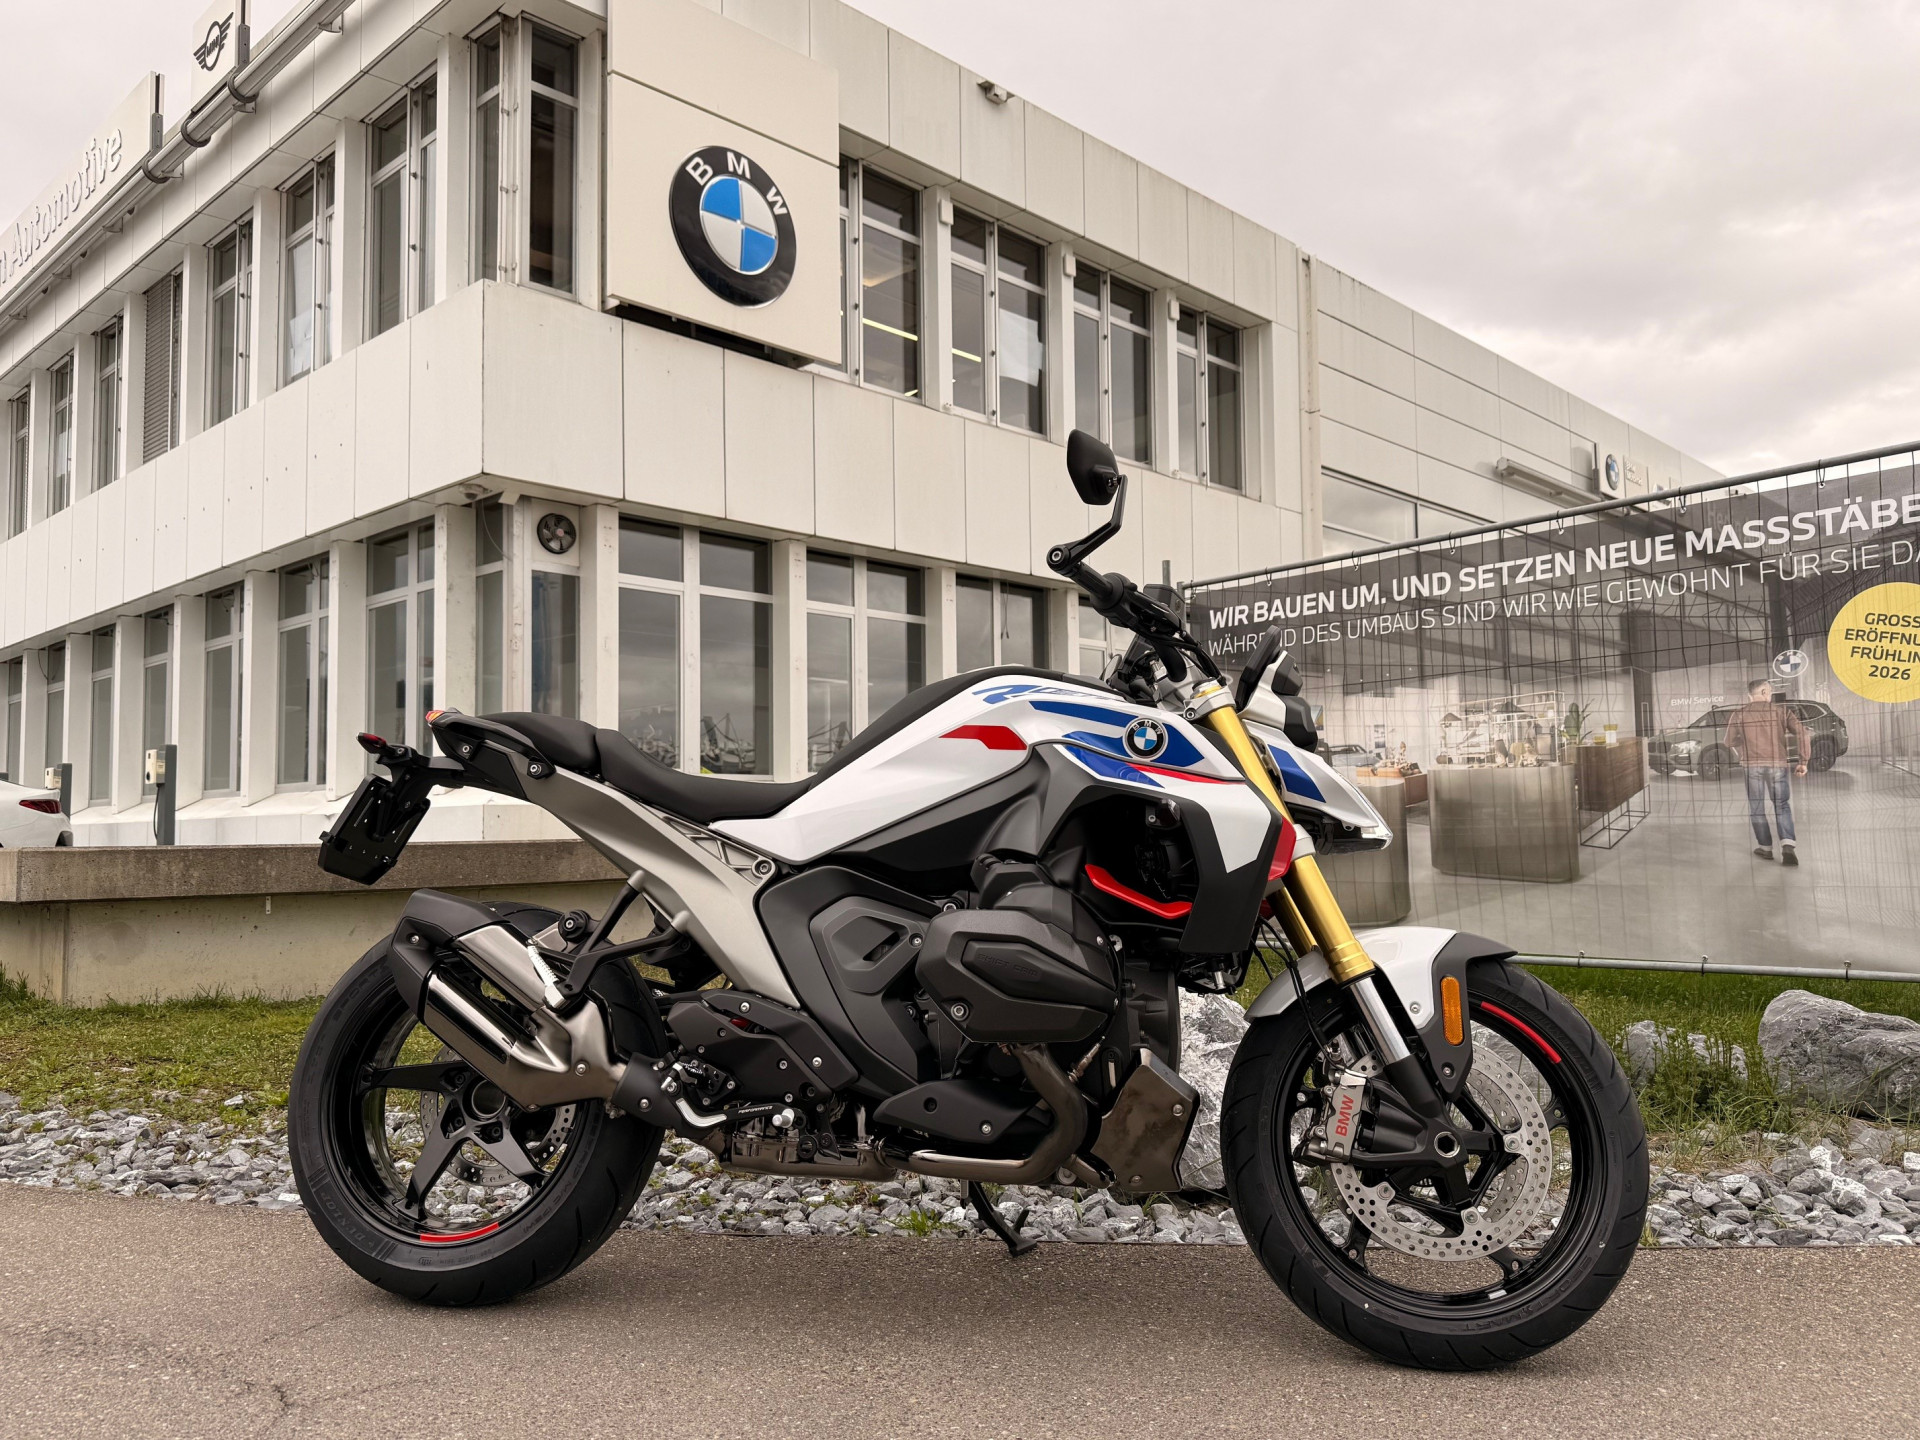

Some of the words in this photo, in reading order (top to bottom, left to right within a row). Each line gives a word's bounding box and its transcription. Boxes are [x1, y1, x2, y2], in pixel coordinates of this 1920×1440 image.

[8, 127, 123, 279] Automotive
[685, 151, 788, 215] BMW
[1209, 604, 1250, 630] WIR
[1253, 589, 1336, 623] BAUEN
[1341, 582, 1387, 611] UM.
[1392, 571, 1452, 602] UND
[1459, 550, 1576, 592] SETZEN
[1585, 533, 1676, 573] NEUE
[1303, 622, 1341, 645] DES
[1347, 608, 1435, 639] UMBAUS
[1442, 600, 1496, 626] SIND
[1502, 593, 1547, 618] WIR
[1553, 584, 1599, 611] WIE
[1606, 562, 1751, 604] GEWOHNT
[1759, 551, 1822, 584] FÜR
[1830, 544, 1880, 574] SIE
[1868, 665, 1912, 681] 2026
[1132, 720, 1164, 735] BMW
[1670, 698, 1692, 707] BMW
[1693, 695, 1725, 705] Service
[1335, 1094, 1355, 1137] BMW
